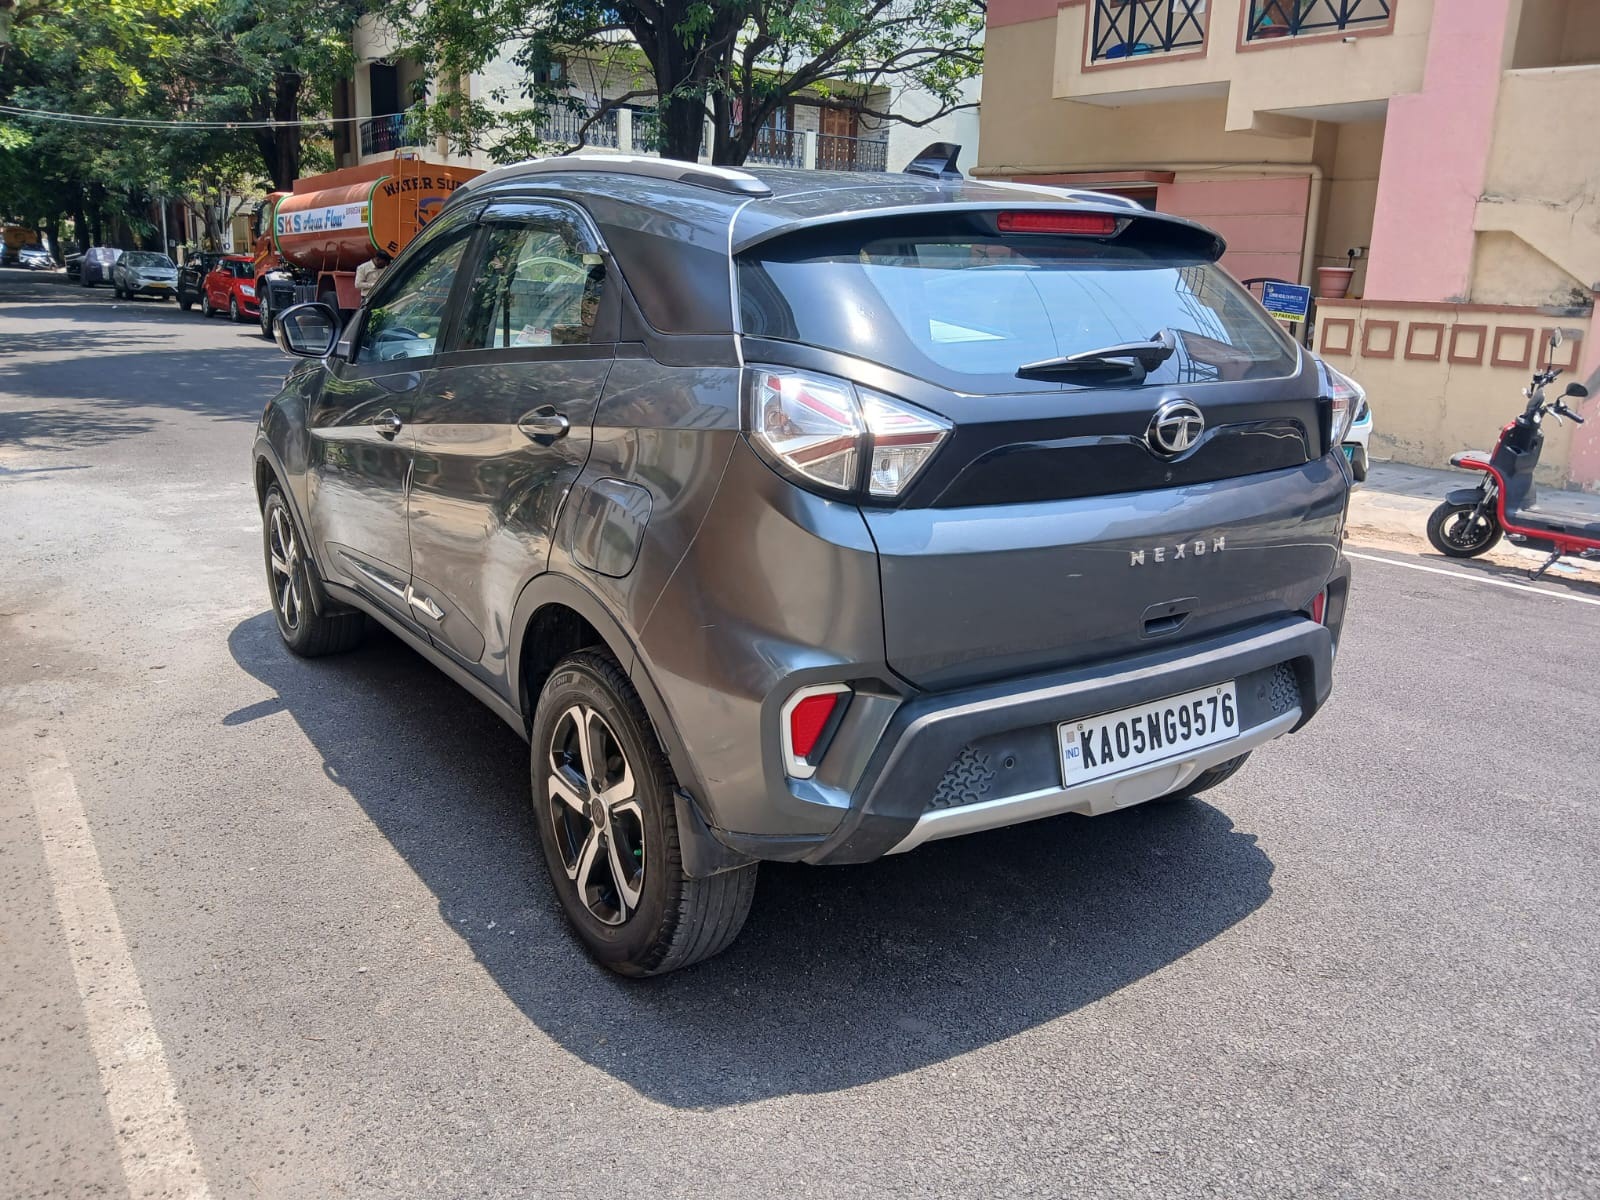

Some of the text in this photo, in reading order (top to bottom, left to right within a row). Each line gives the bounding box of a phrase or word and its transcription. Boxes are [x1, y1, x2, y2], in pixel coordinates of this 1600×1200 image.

[383, 176, 433, 197] WATER
[277, 214, 302, 234] SKS
[1278, 312, 1300, 321] PARKING
[1130, 536, 1225, 567] NEXON
[1080, 693, 1235, 769] KA05NG9576
[1065, 746, 1080, 760] IND
